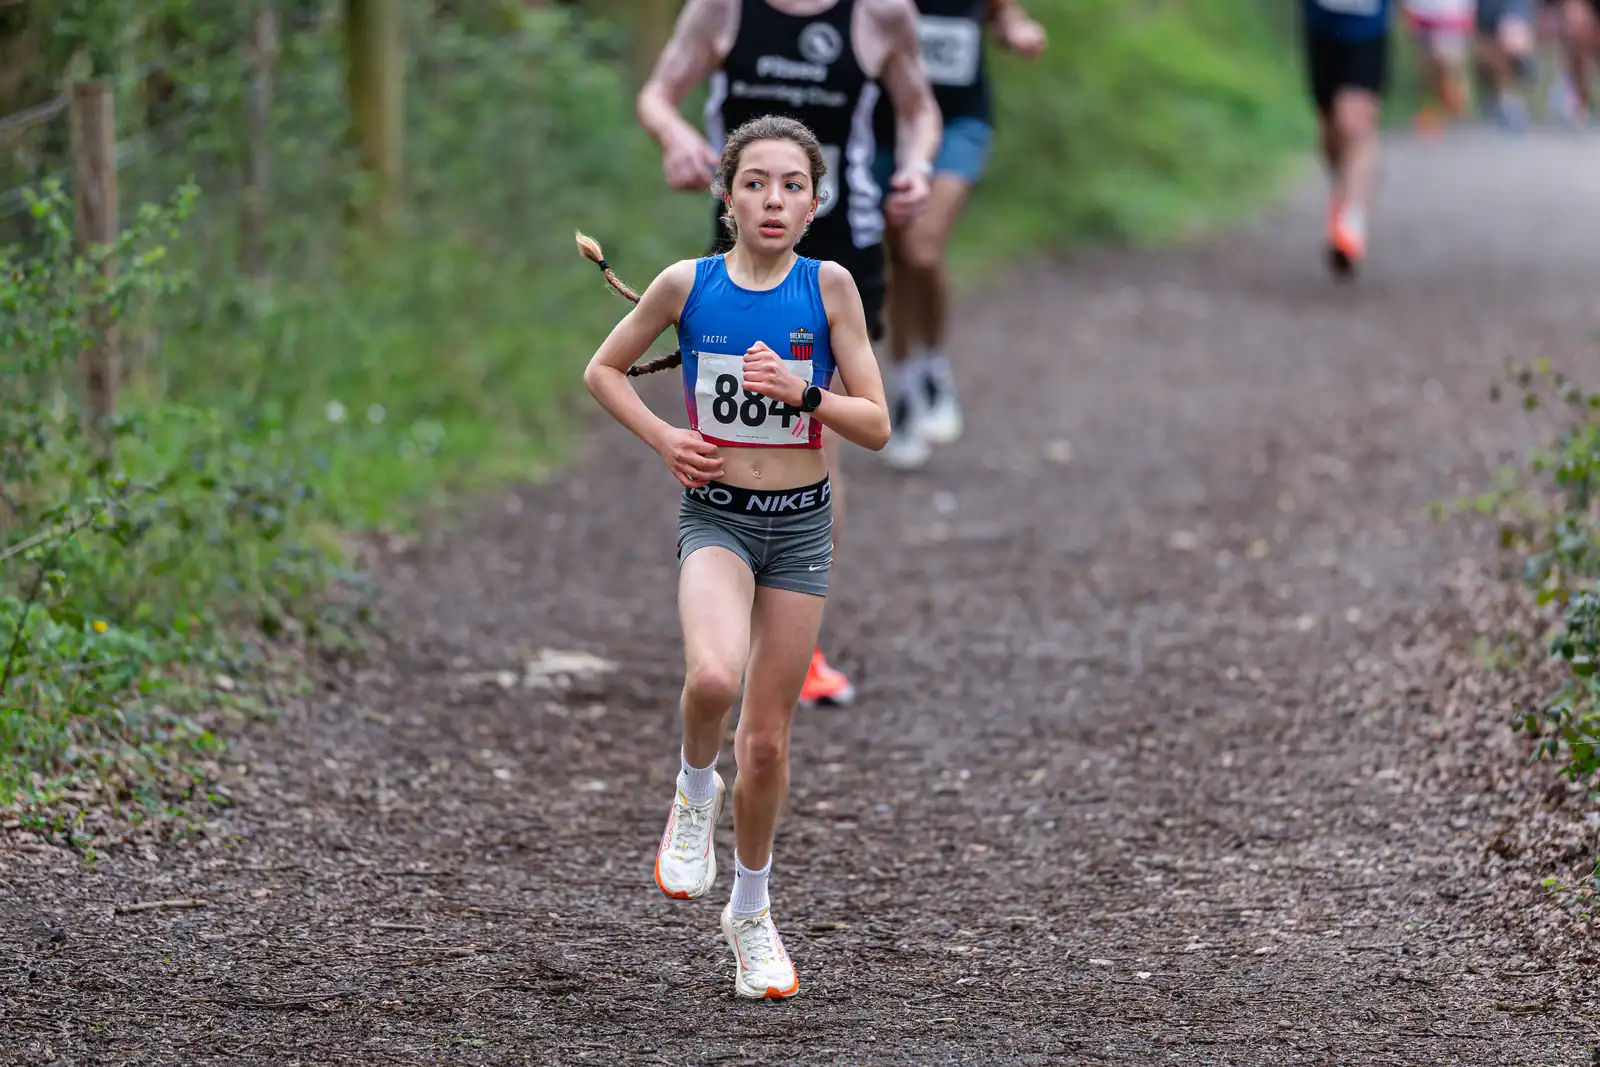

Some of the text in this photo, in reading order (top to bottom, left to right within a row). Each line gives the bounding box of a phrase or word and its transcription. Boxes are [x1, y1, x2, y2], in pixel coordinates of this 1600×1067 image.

[702, 335, 728, 344] TACTIC
[712, 373, 799, 428] 884
[690, 484, 733, 505] RO
[745, 489, 818, 512] NIKE
